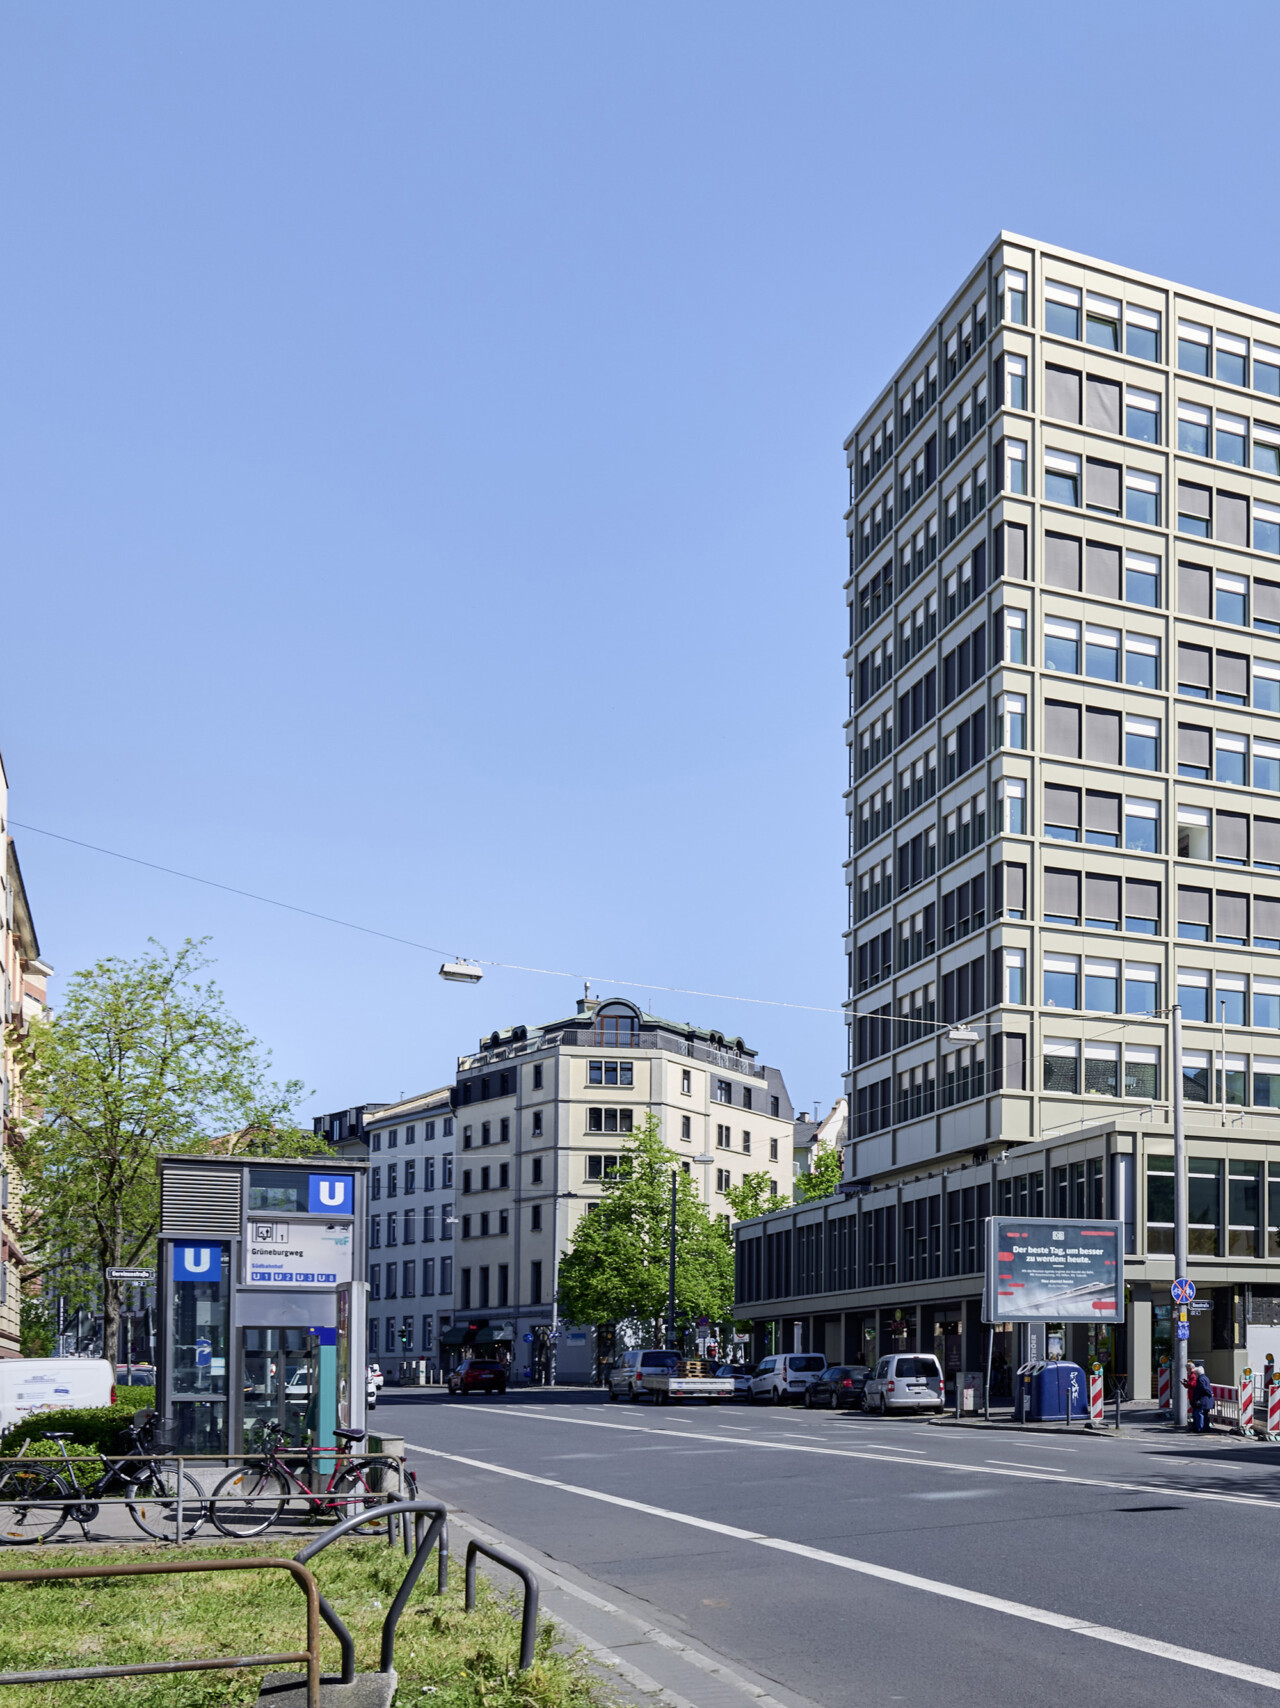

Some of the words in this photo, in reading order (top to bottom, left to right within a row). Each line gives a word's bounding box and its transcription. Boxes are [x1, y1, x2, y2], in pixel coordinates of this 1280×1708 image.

[319, 1181, 345, 1206] U
[251, 1248, 304, 1258] Grüneburgweg
[1012, 1246, 1027, 1254] Der
[1028, 1246, 1049, 1254] beste
[1049, 1247, 1065, 1255] Tag,
[1079, 1247, 1104, 1255] besser
[184, 1248, 211, 1273] U
